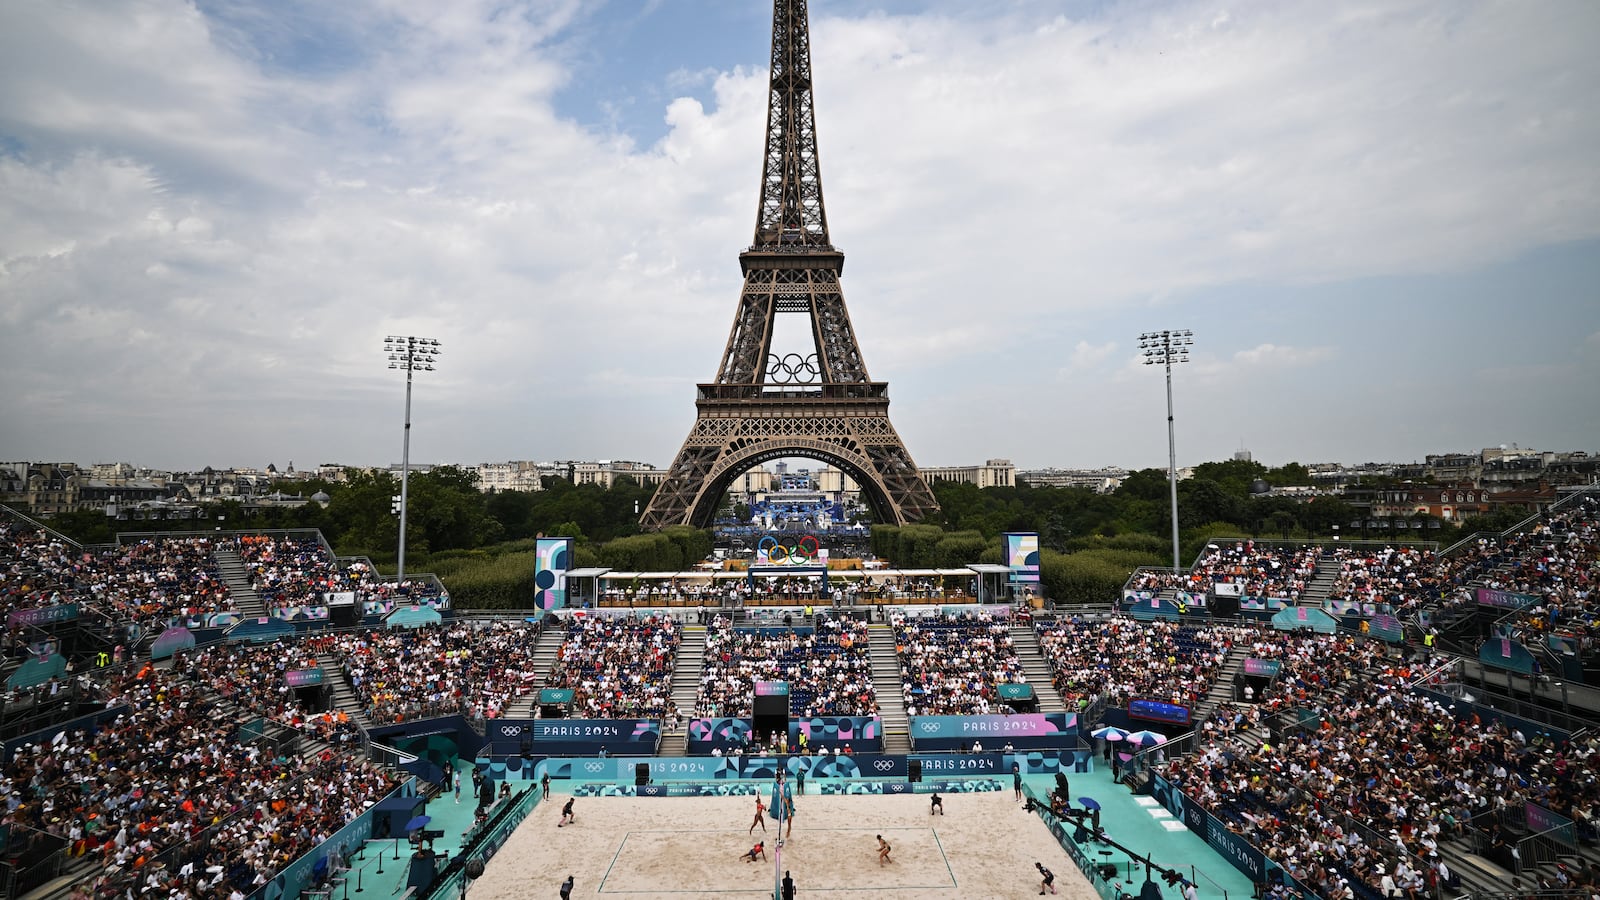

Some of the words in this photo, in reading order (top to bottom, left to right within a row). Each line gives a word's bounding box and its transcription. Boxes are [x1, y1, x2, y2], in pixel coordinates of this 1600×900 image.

[543, 726, 580, 735] PARIS
[585, 726, 618, 735] 2024
[963, 722, 999, 731] PARIS
[1003, 721, 1036, 730] 2024
[627, 763, 665, 772] PIS
[670, 763, 704, 772] 2024
[959, 759, 994, 769] 2024
[1212, 828, 1235, 854] PARIS
[1236, 848, 1258, 875] 2024
